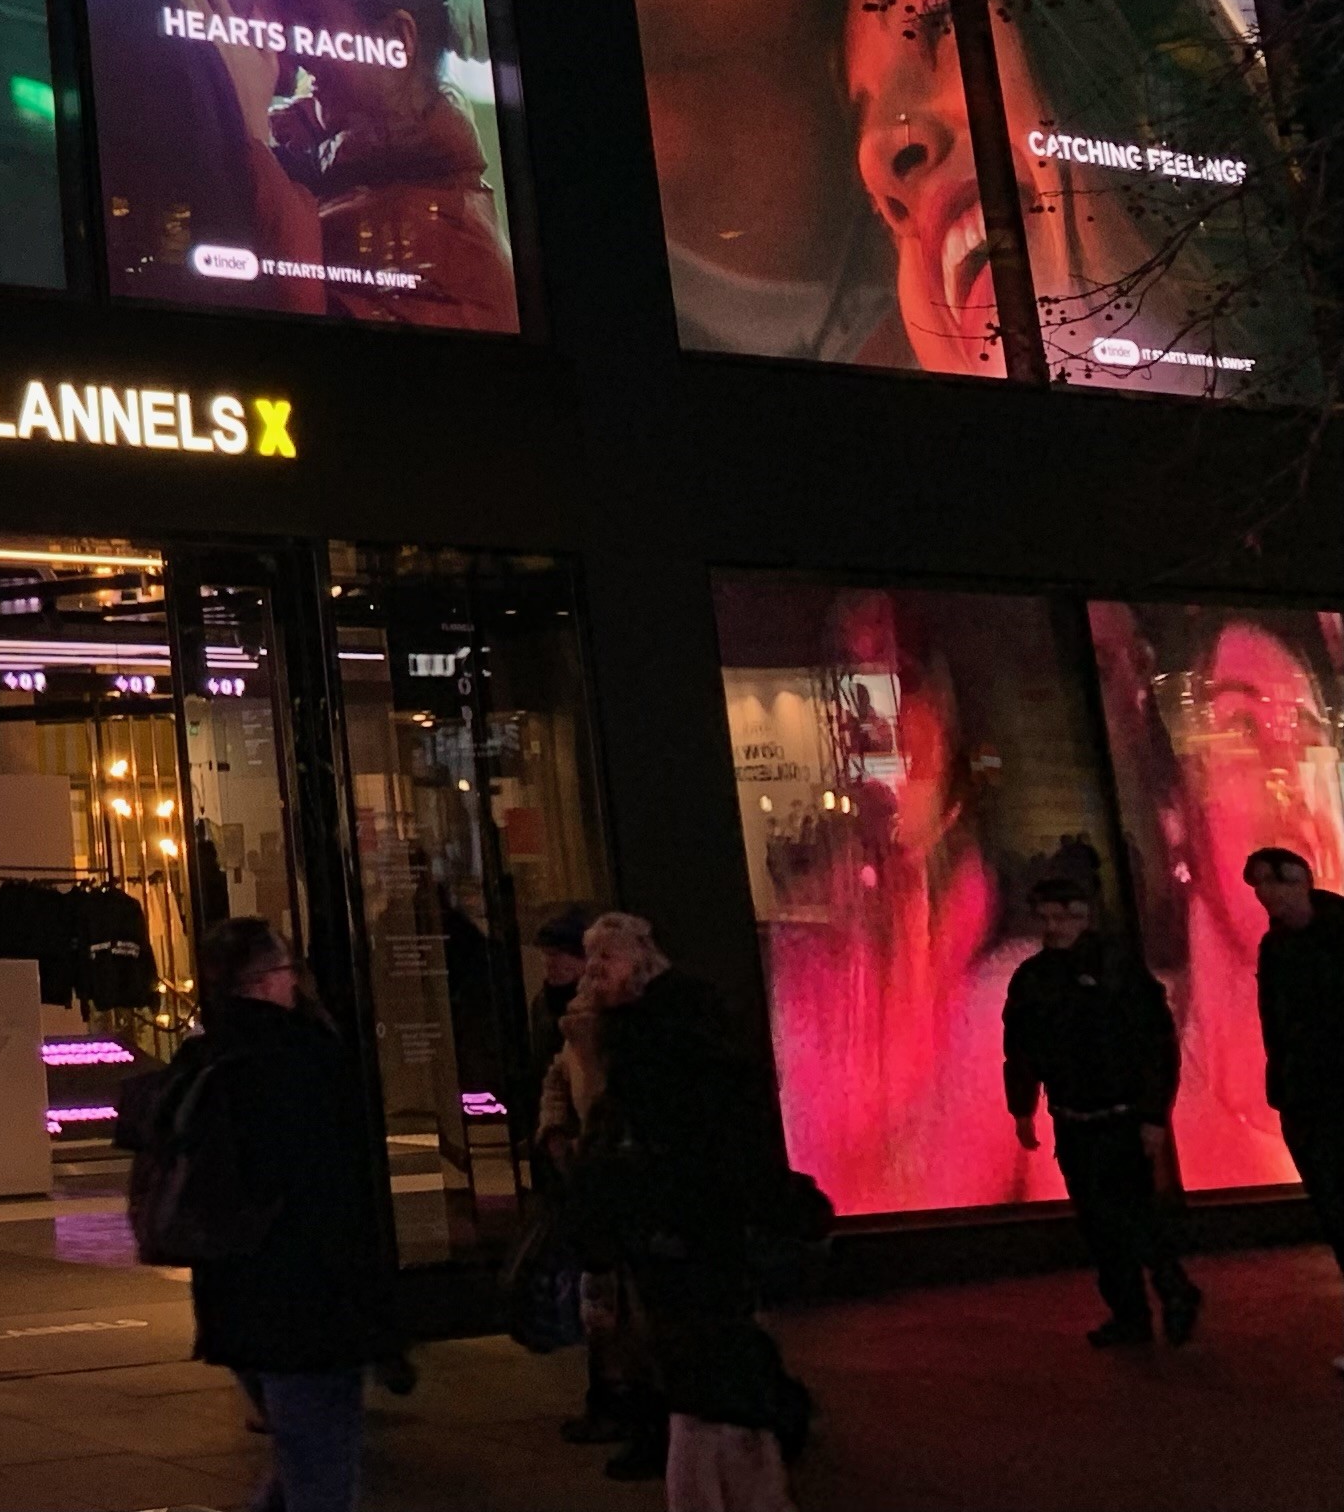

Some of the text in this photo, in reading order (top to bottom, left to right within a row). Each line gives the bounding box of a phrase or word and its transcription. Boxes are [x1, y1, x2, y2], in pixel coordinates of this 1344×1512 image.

[163, 6, 408, 70] HEARTS RACING
[1028, 130, 1247, 185] CATCHING FEELINGS
[262, 259, 276, 275] IT
[277, 260, 326, 281] STARTS
[326, 265, 363, 284] WITH
[364, 269, 375, 285] A
